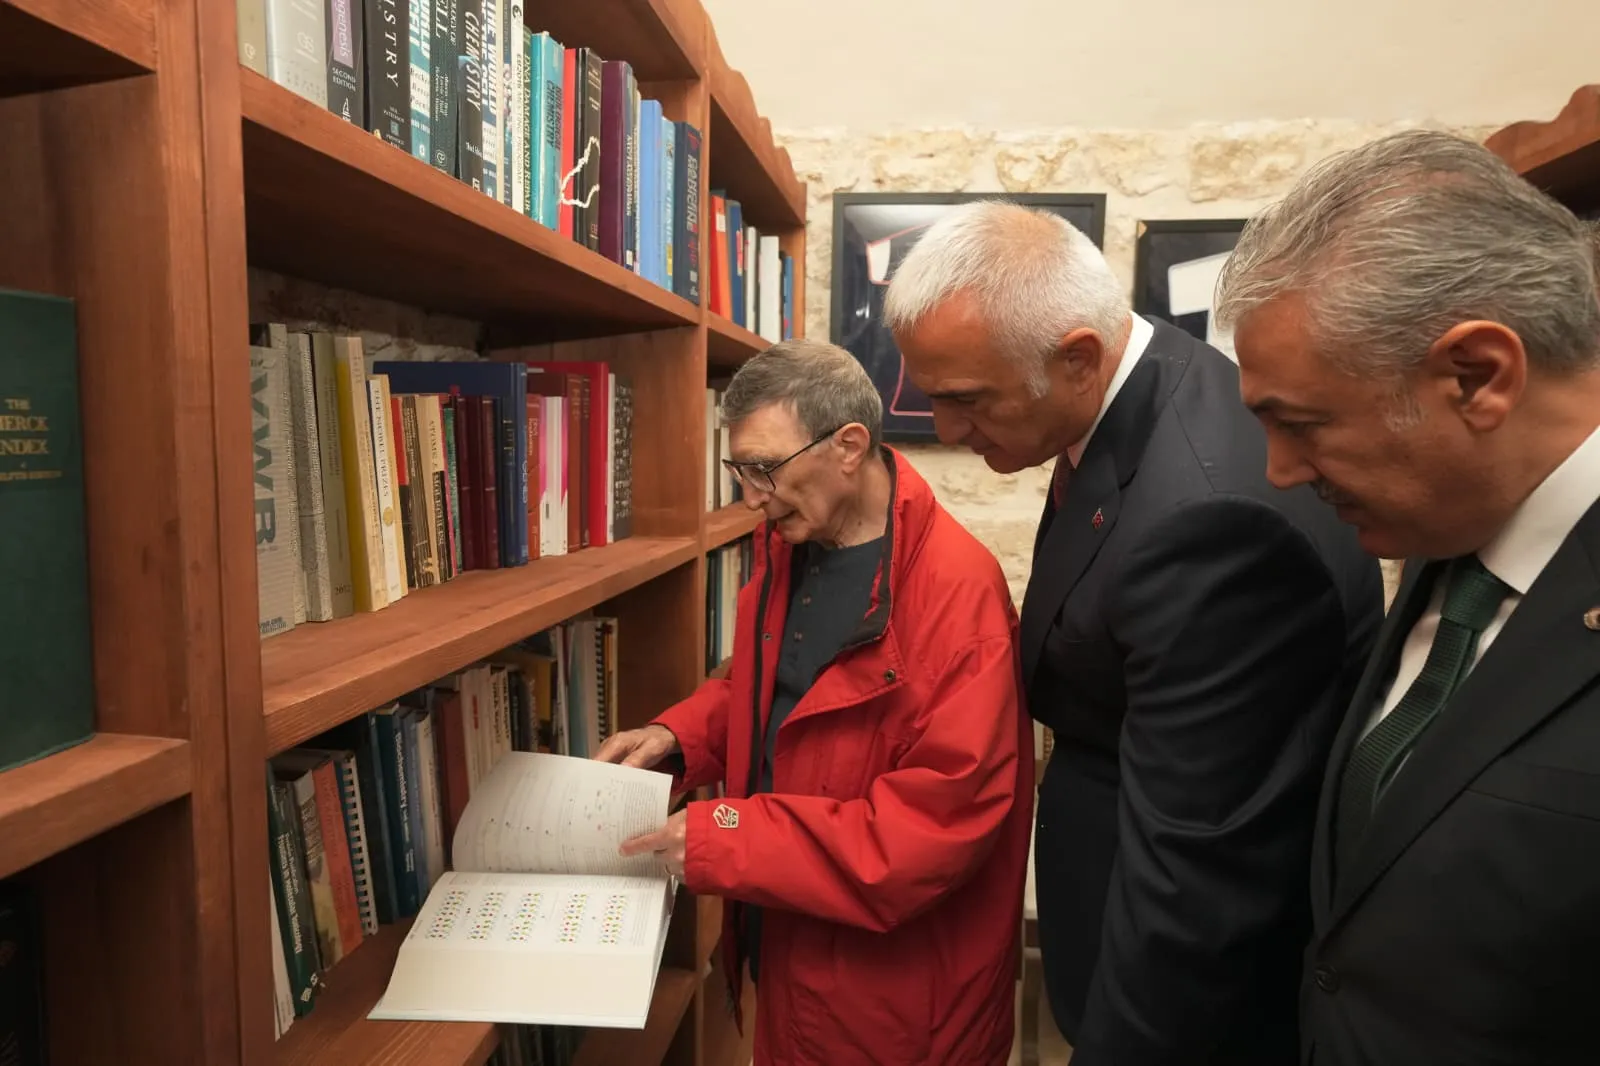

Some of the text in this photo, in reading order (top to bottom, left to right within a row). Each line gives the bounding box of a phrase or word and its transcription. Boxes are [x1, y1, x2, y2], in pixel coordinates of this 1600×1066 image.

[332, 67, 356, 84] SECOND
[465, 11, 481, 112] CHEMISTRY
[332, 76, 356, 92] EDITION
[523, 53, 531, 211] DNA DAMAGE AND REPAIR
[546, 80, 555, 148] CHEMISTRY
[554, 85, 562, 151] BIOLOGICAL
[4, 399, 31, 411] THE
[376, 416, 385, 453] NOBEL
[379, 457, 389, 498] PRIZES
